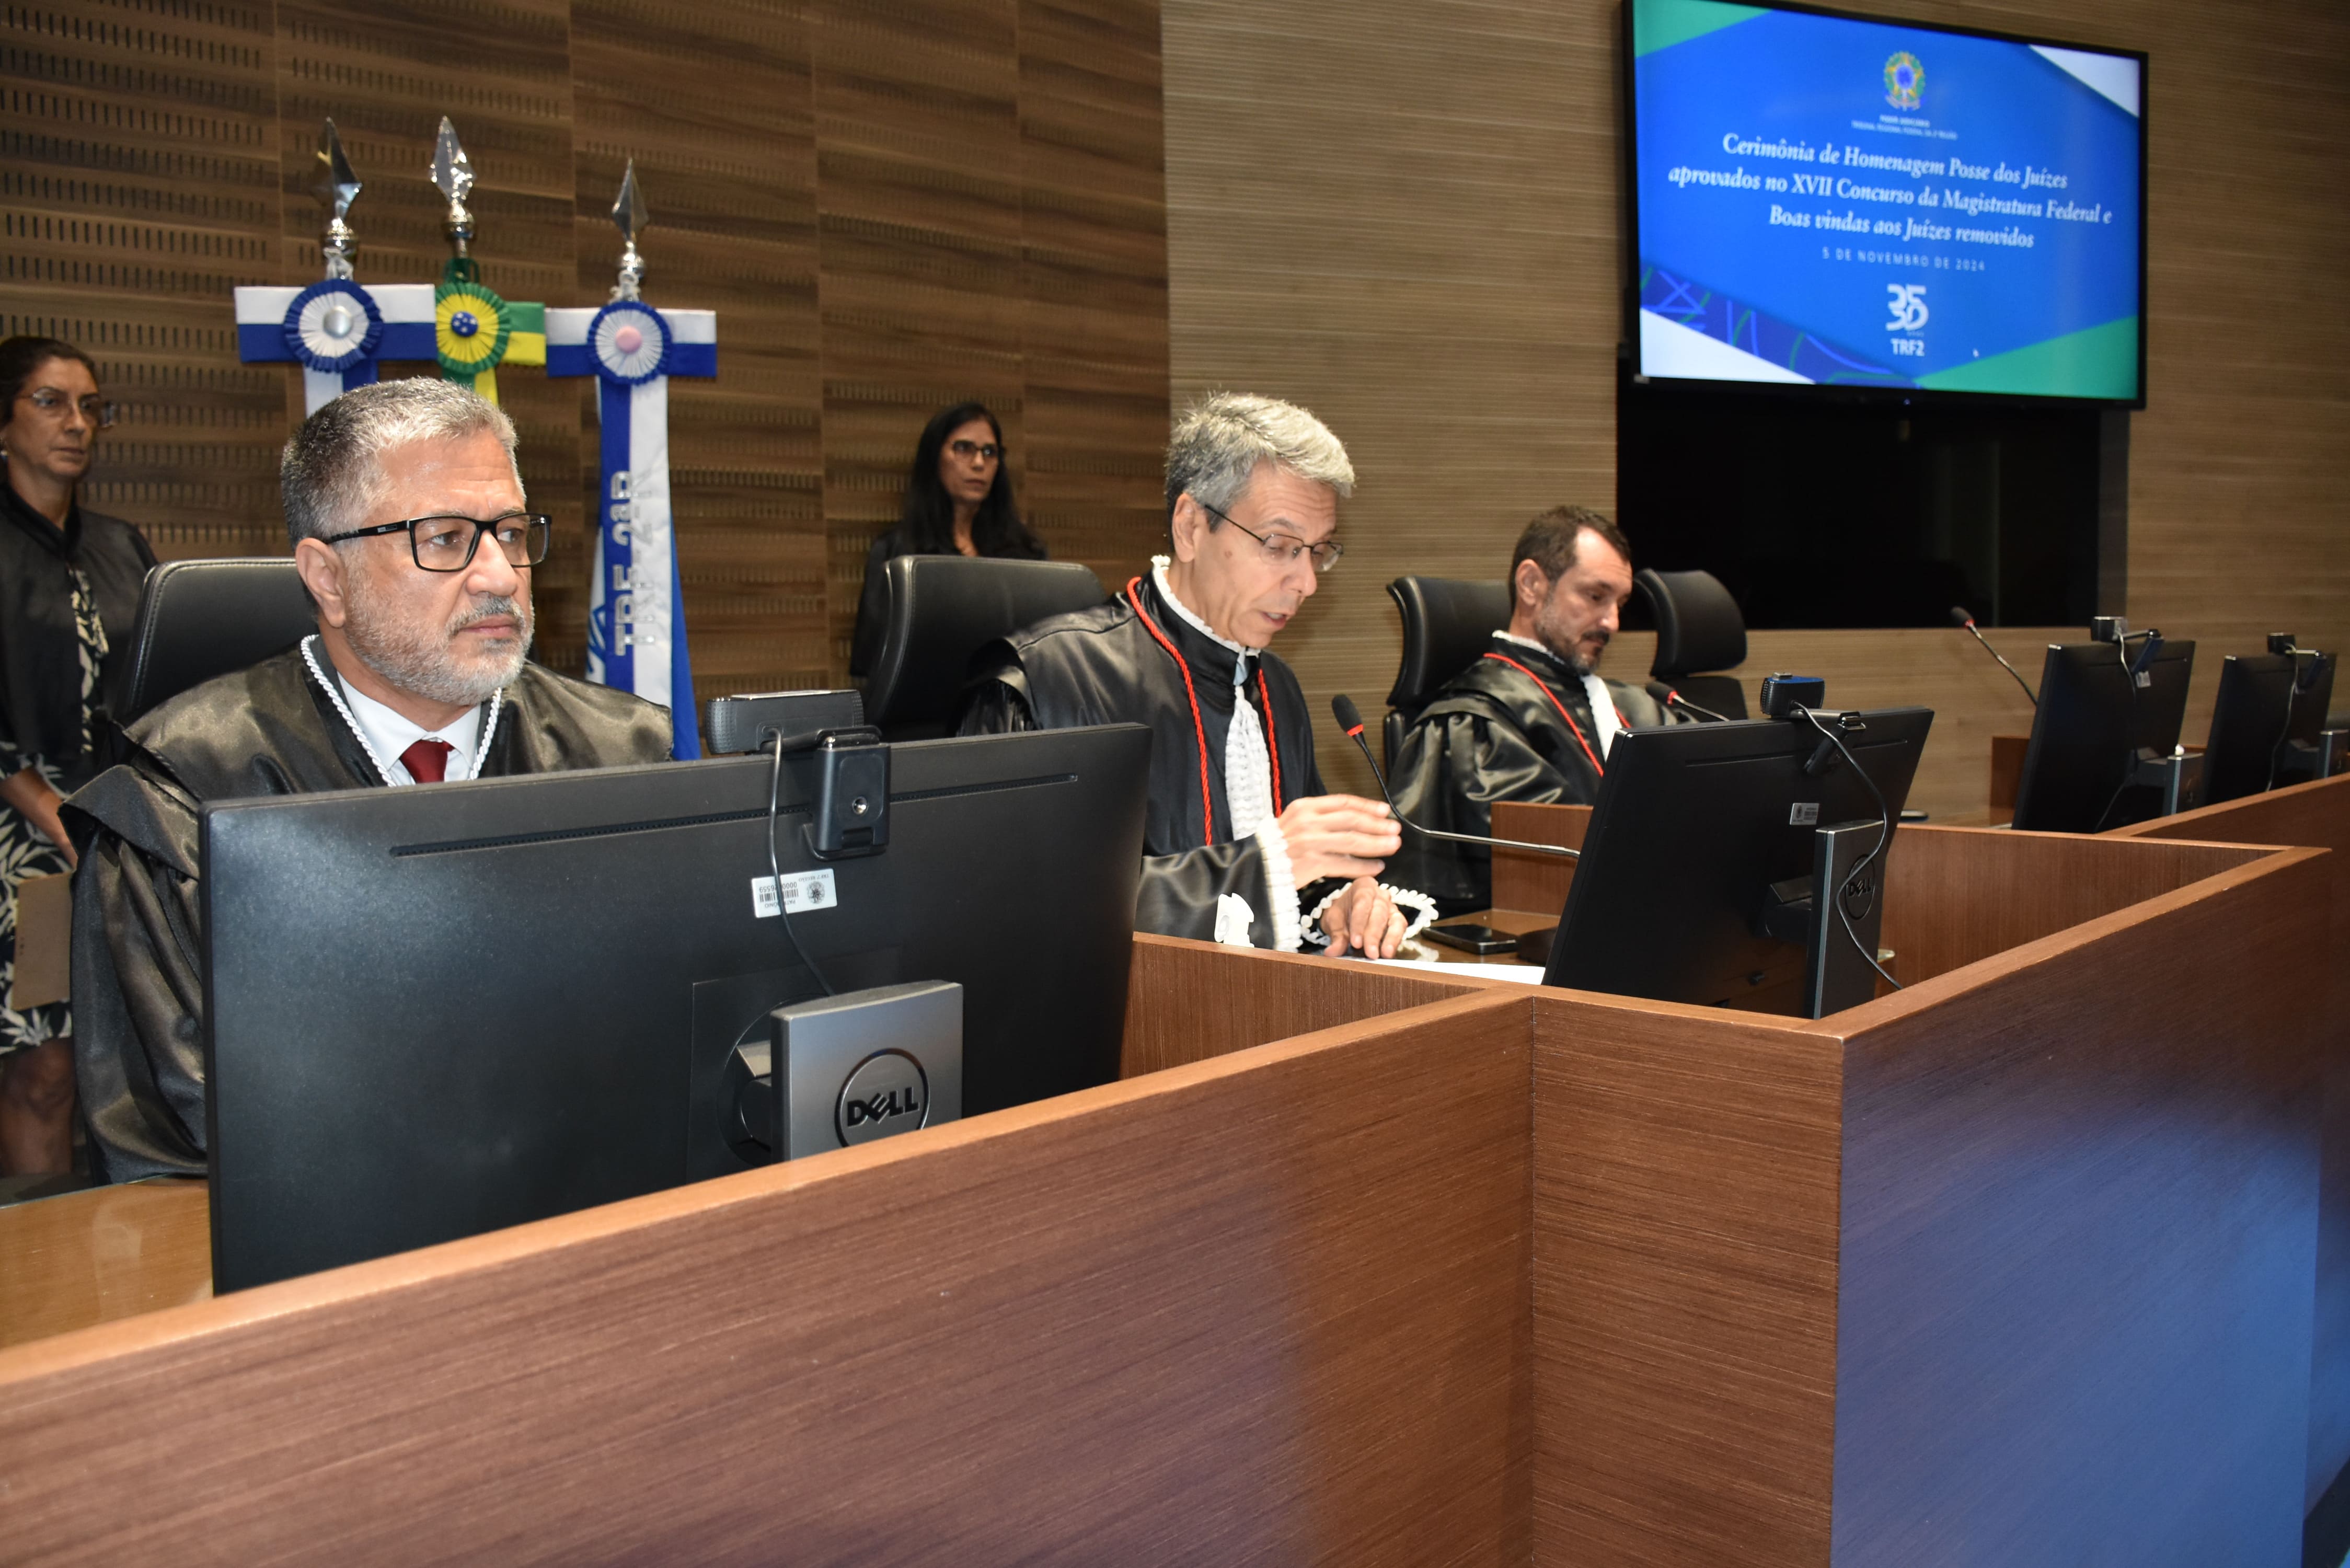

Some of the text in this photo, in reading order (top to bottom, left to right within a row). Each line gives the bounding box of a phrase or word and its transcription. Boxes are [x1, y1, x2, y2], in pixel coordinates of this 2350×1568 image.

[1723, 133, 2068, 189] Cerimônia de Homenagem Posse dos Juízes
[1668, 166, 2112, 224] aprovados no XVII Concurso da Magistratura Federal e
[1769, 204, 2034, 248] Boas vindas aos Juízes removidos
[1822, 246, 1985, 272] 5 DE NOVEMBRO DE 2024
[1891, 338, 1925, 356] TRF2
[847, 1087, 920, 1127] DELL
